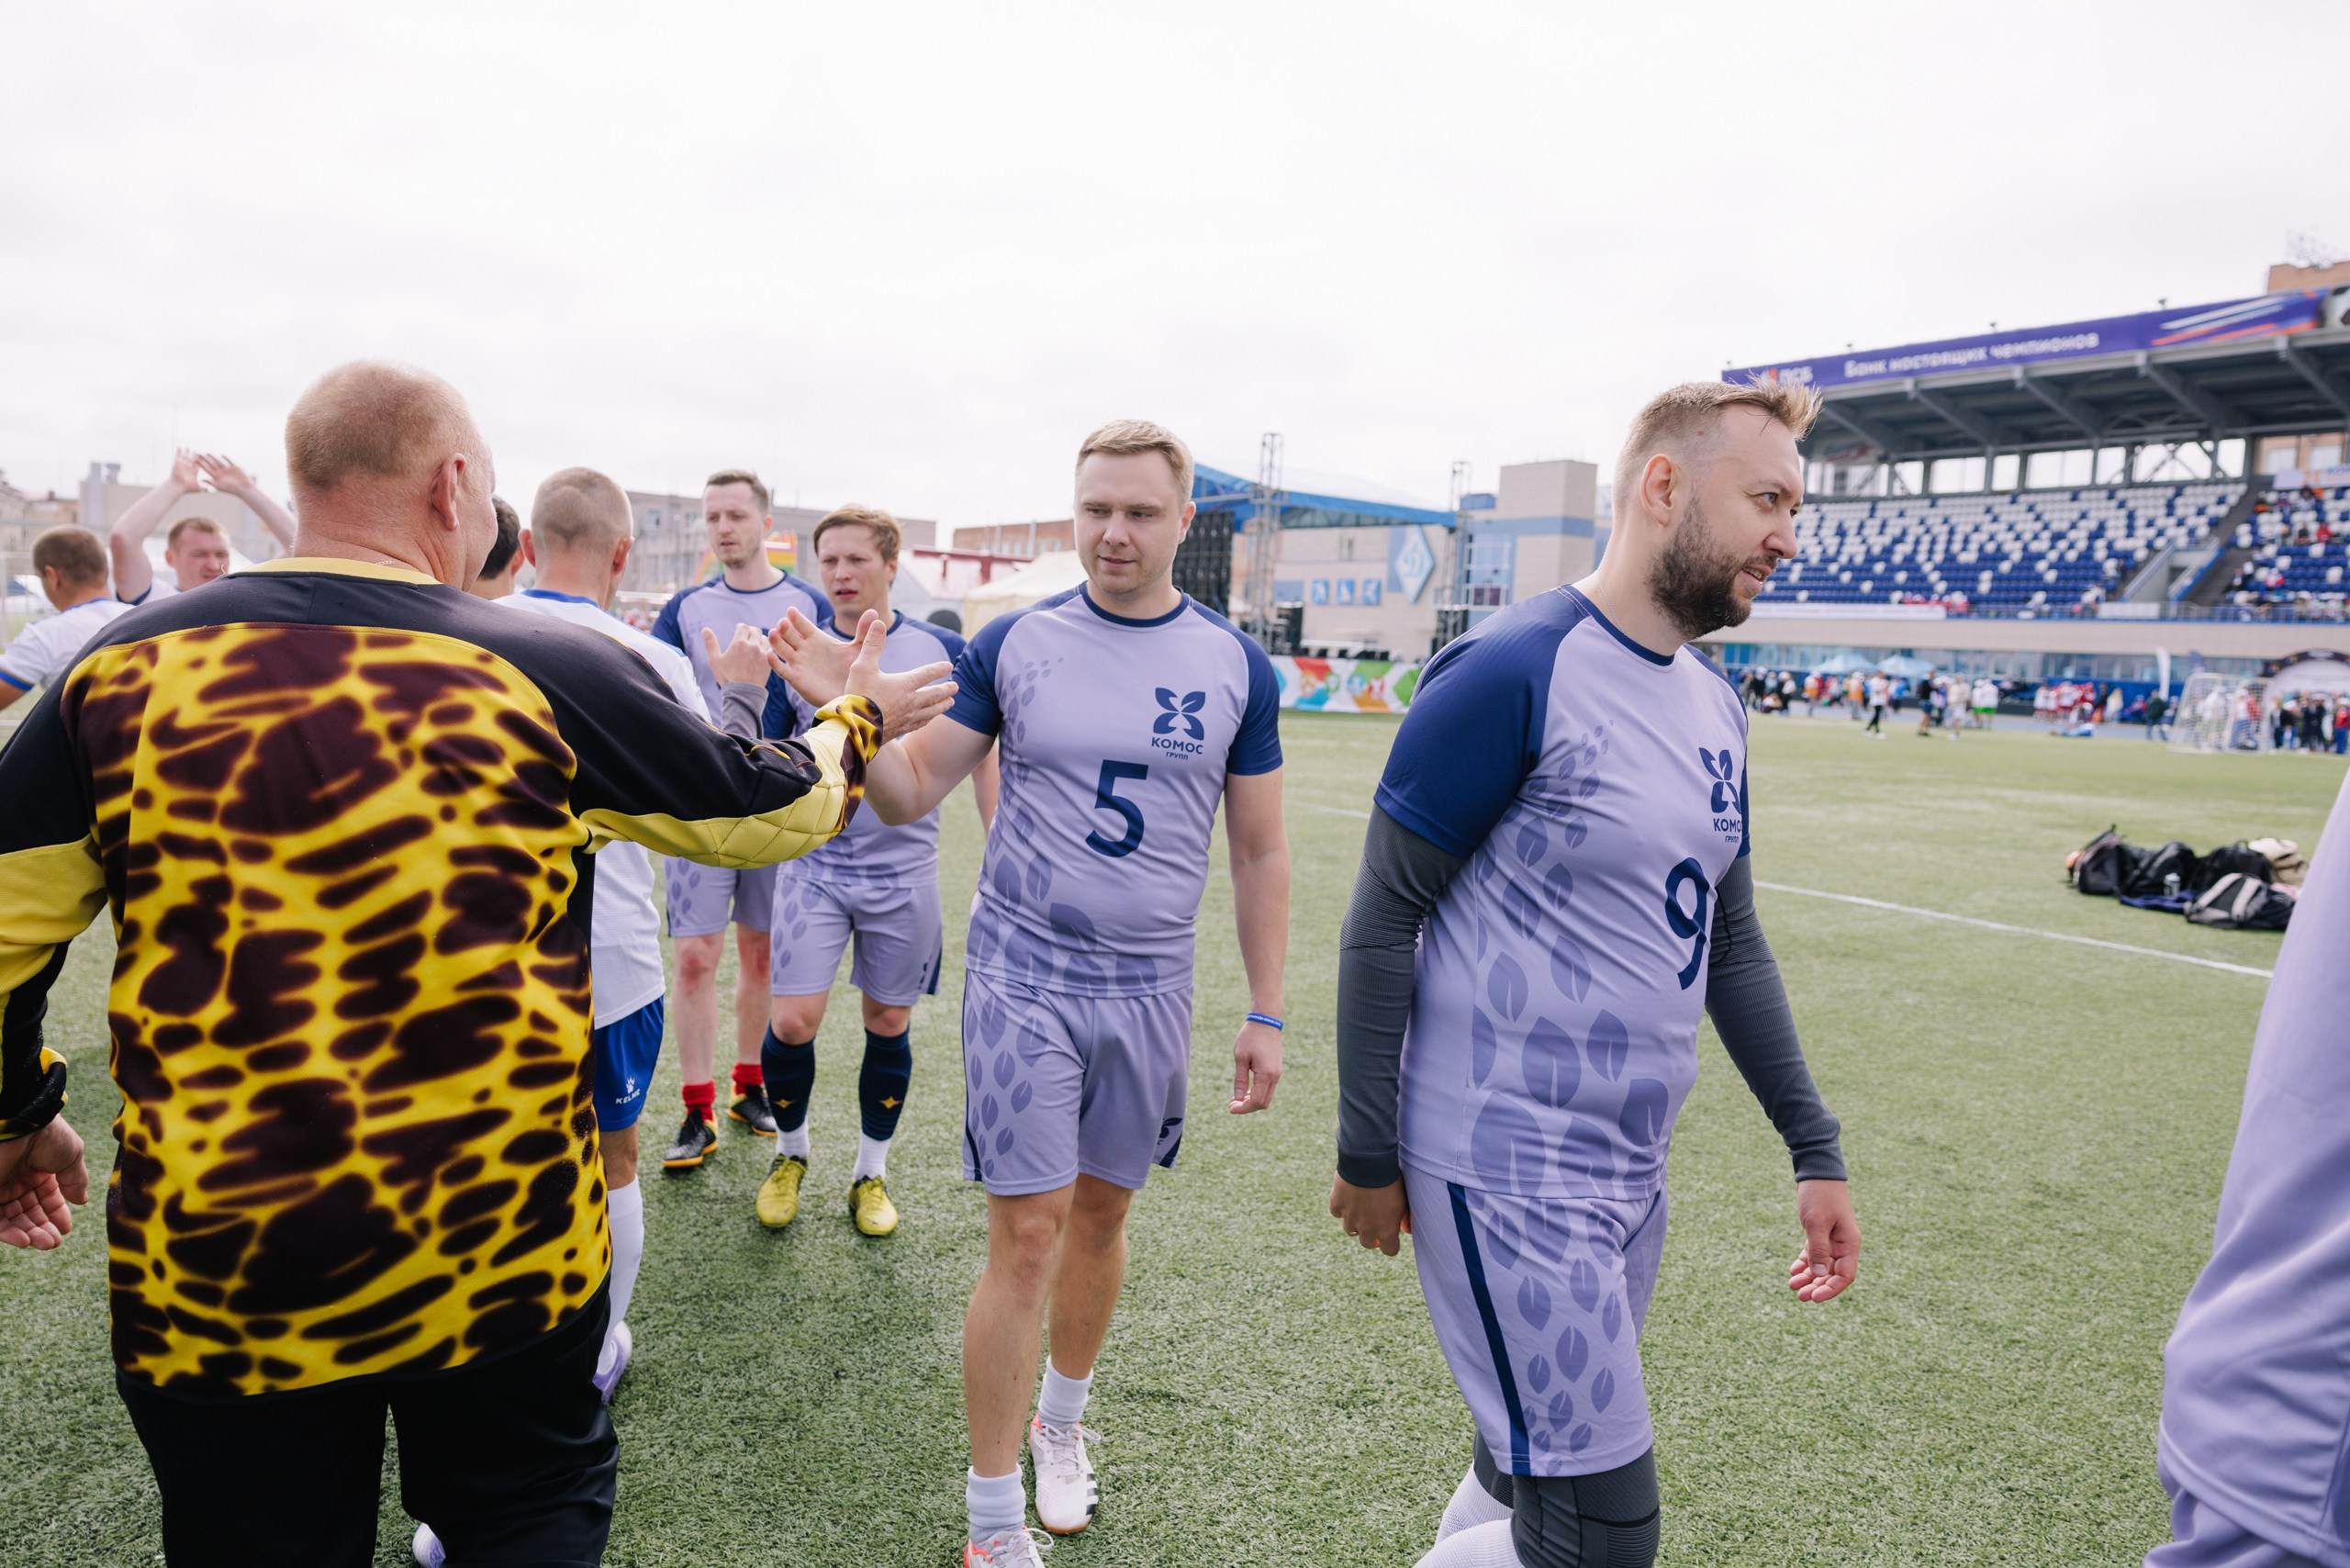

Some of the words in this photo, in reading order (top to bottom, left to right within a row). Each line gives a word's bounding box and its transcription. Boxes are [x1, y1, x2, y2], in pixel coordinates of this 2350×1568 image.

[1844, 359, 1887, 378] Банк
[1888, 346, 1988, 372] настоящих
[1989, 332, 2100, 359] чемпионов
[1151, 737, 1203, 755] КОМОС
[1166, 752, 1189, 760] ГРУПП
[1085, 759, 1149, 857] 5
[1713, 818, 1742, 833] КОМО
[1664, 857, 1710, 991] 9
[615, 1088, 641, 1104] KELME
